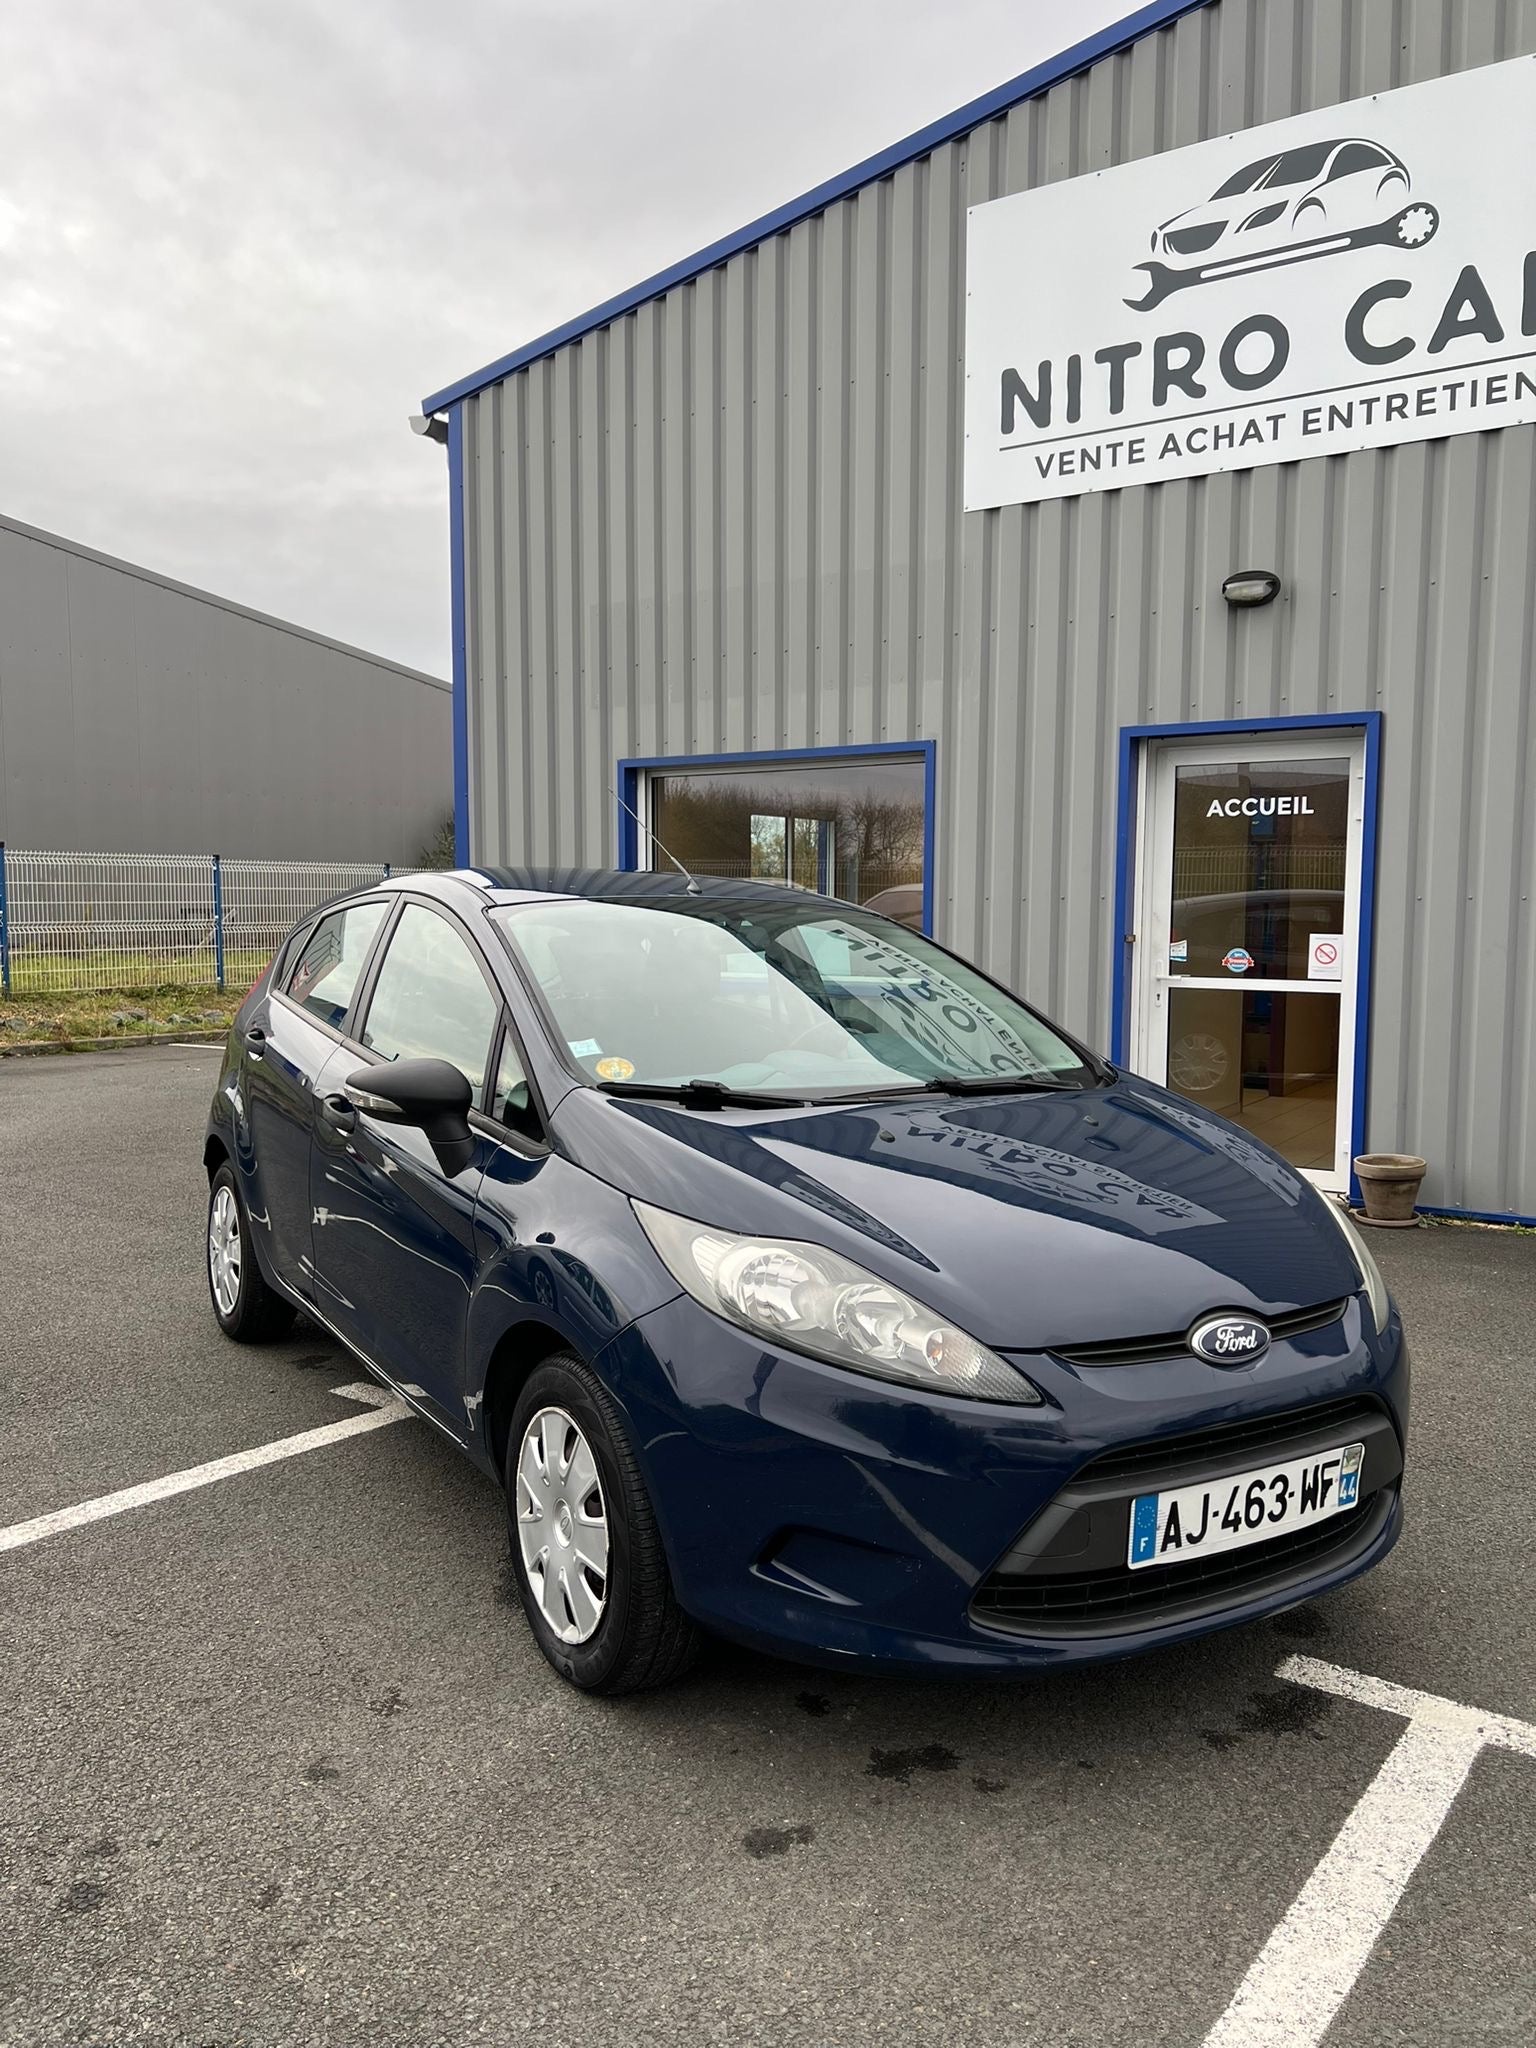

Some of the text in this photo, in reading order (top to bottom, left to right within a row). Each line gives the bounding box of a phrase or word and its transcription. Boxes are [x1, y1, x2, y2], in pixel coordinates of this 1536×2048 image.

[1000, 313, 1290, 435] NITRO
[1035, 371, 1536, 480] VENTE ACHAT ENTRETIEN
[1206, 796, 1315, 818] ACCUEIL
[1214, 1324, 1258, 1353] Ford
[1339, 1476, 1356, 1500] 44
[1160, 1459, 1341, 1553] AJ-463-WF
[1139, 1536, 1149, 1553] F
